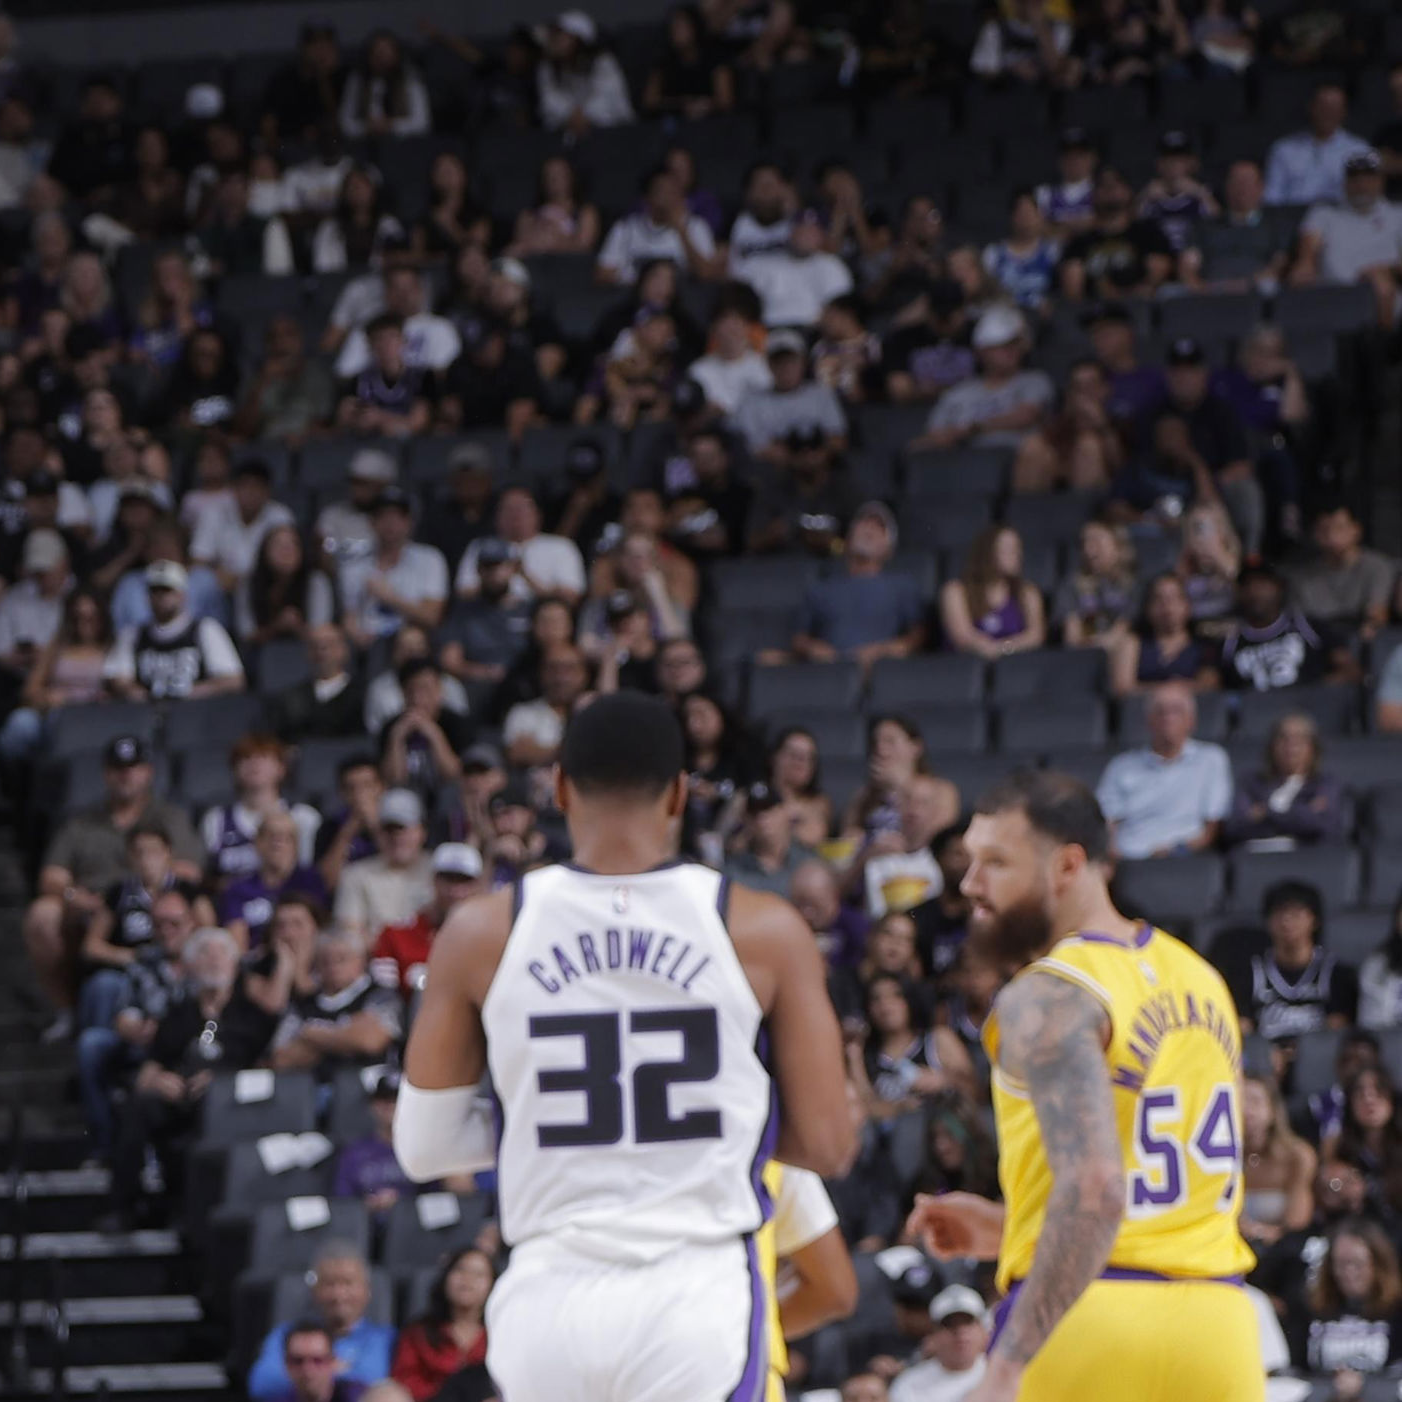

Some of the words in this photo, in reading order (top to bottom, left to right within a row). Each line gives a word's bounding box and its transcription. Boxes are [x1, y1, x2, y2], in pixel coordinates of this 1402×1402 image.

[527, 927, 712, 996] CARDWELL
[527, 1006, 725, 1149] 32
[1126, 1082, 1244, 1222] 54
